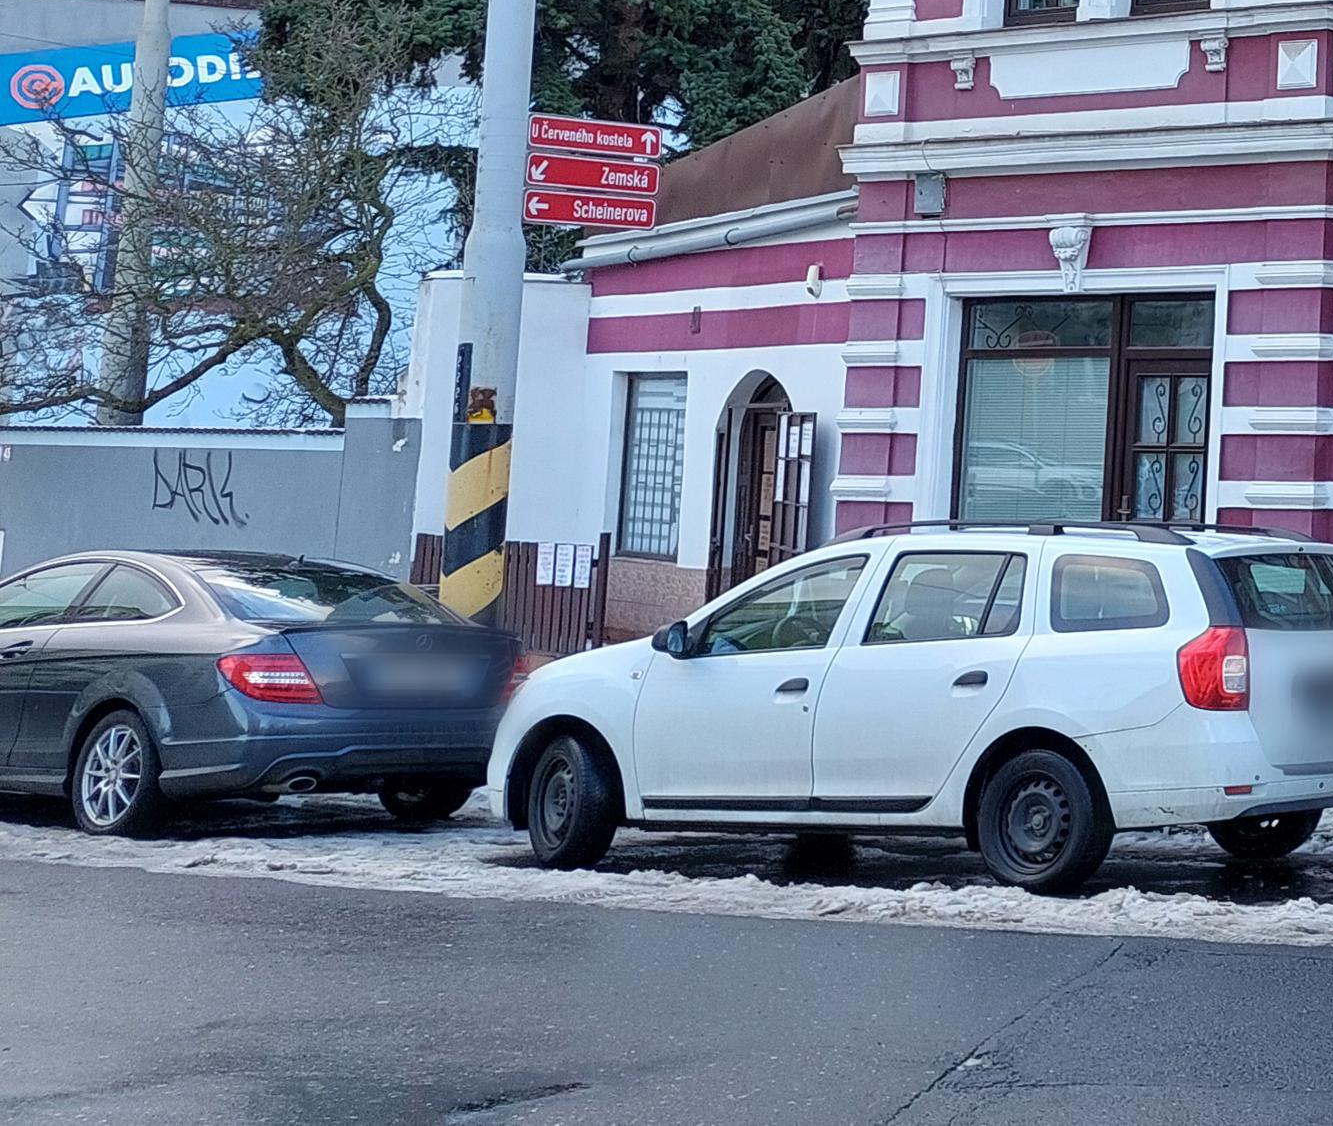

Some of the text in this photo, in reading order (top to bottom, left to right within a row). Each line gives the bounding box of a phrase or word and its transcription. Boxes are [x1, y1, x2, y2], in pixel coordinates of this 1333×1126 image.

[68, 52, 262, 97] AUODI
[531, 120, 633, 148] U Červeného kostela
[600, 166, 649, 189] Zemská
